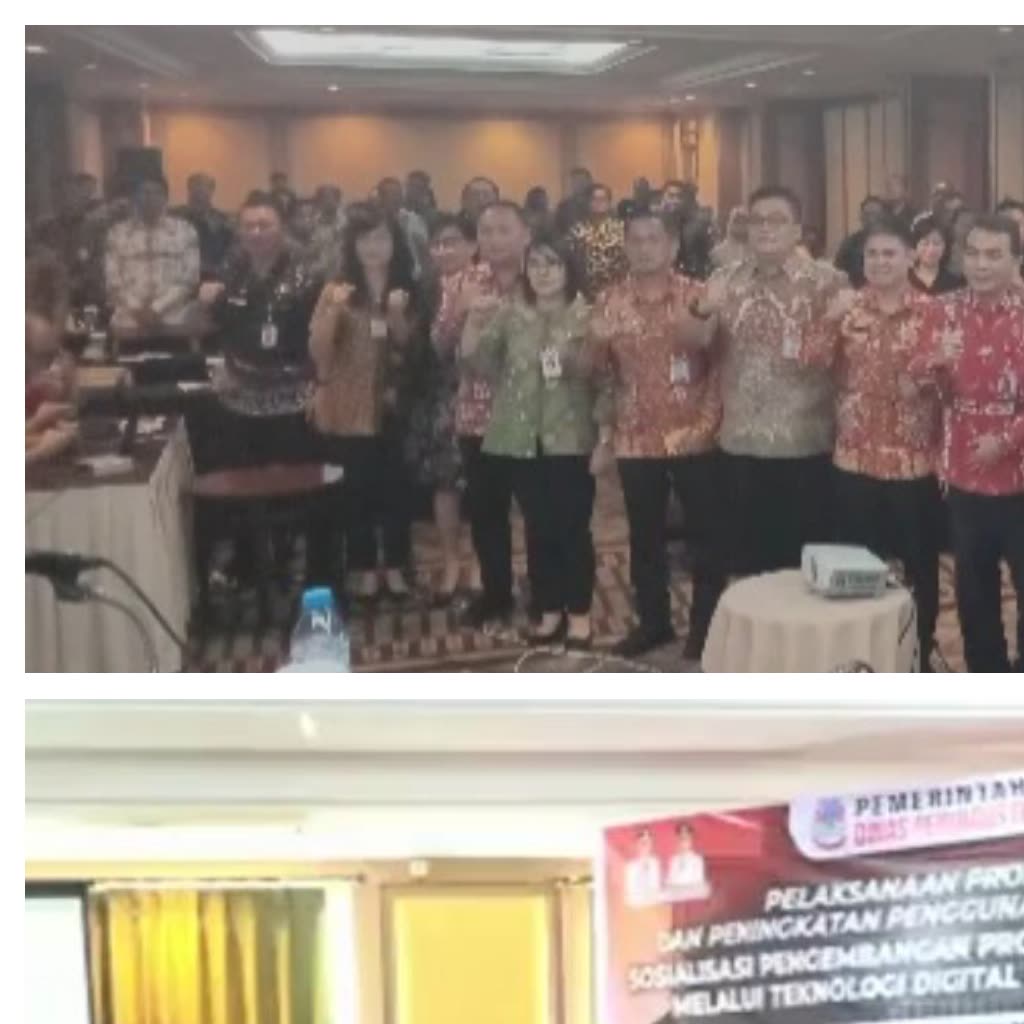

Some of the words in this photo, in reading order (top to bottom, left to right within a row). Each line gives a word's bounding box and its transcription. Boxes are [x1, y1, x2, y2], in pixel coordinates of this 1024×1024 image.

[764, 867, 961, 911] PELAKSANAAN
[708, 909, 881, 948] PENINGKATAN
[628, 955, 754, 991] SOSIALISASI
[759, 935, 970, 977] PENGEMBANGAN
[671, 987, 765, 1018] MELALUI
[771, 974, 907, 1011] TEKNOLOGI
[912, 963, 1021, 998] DIGITAL
